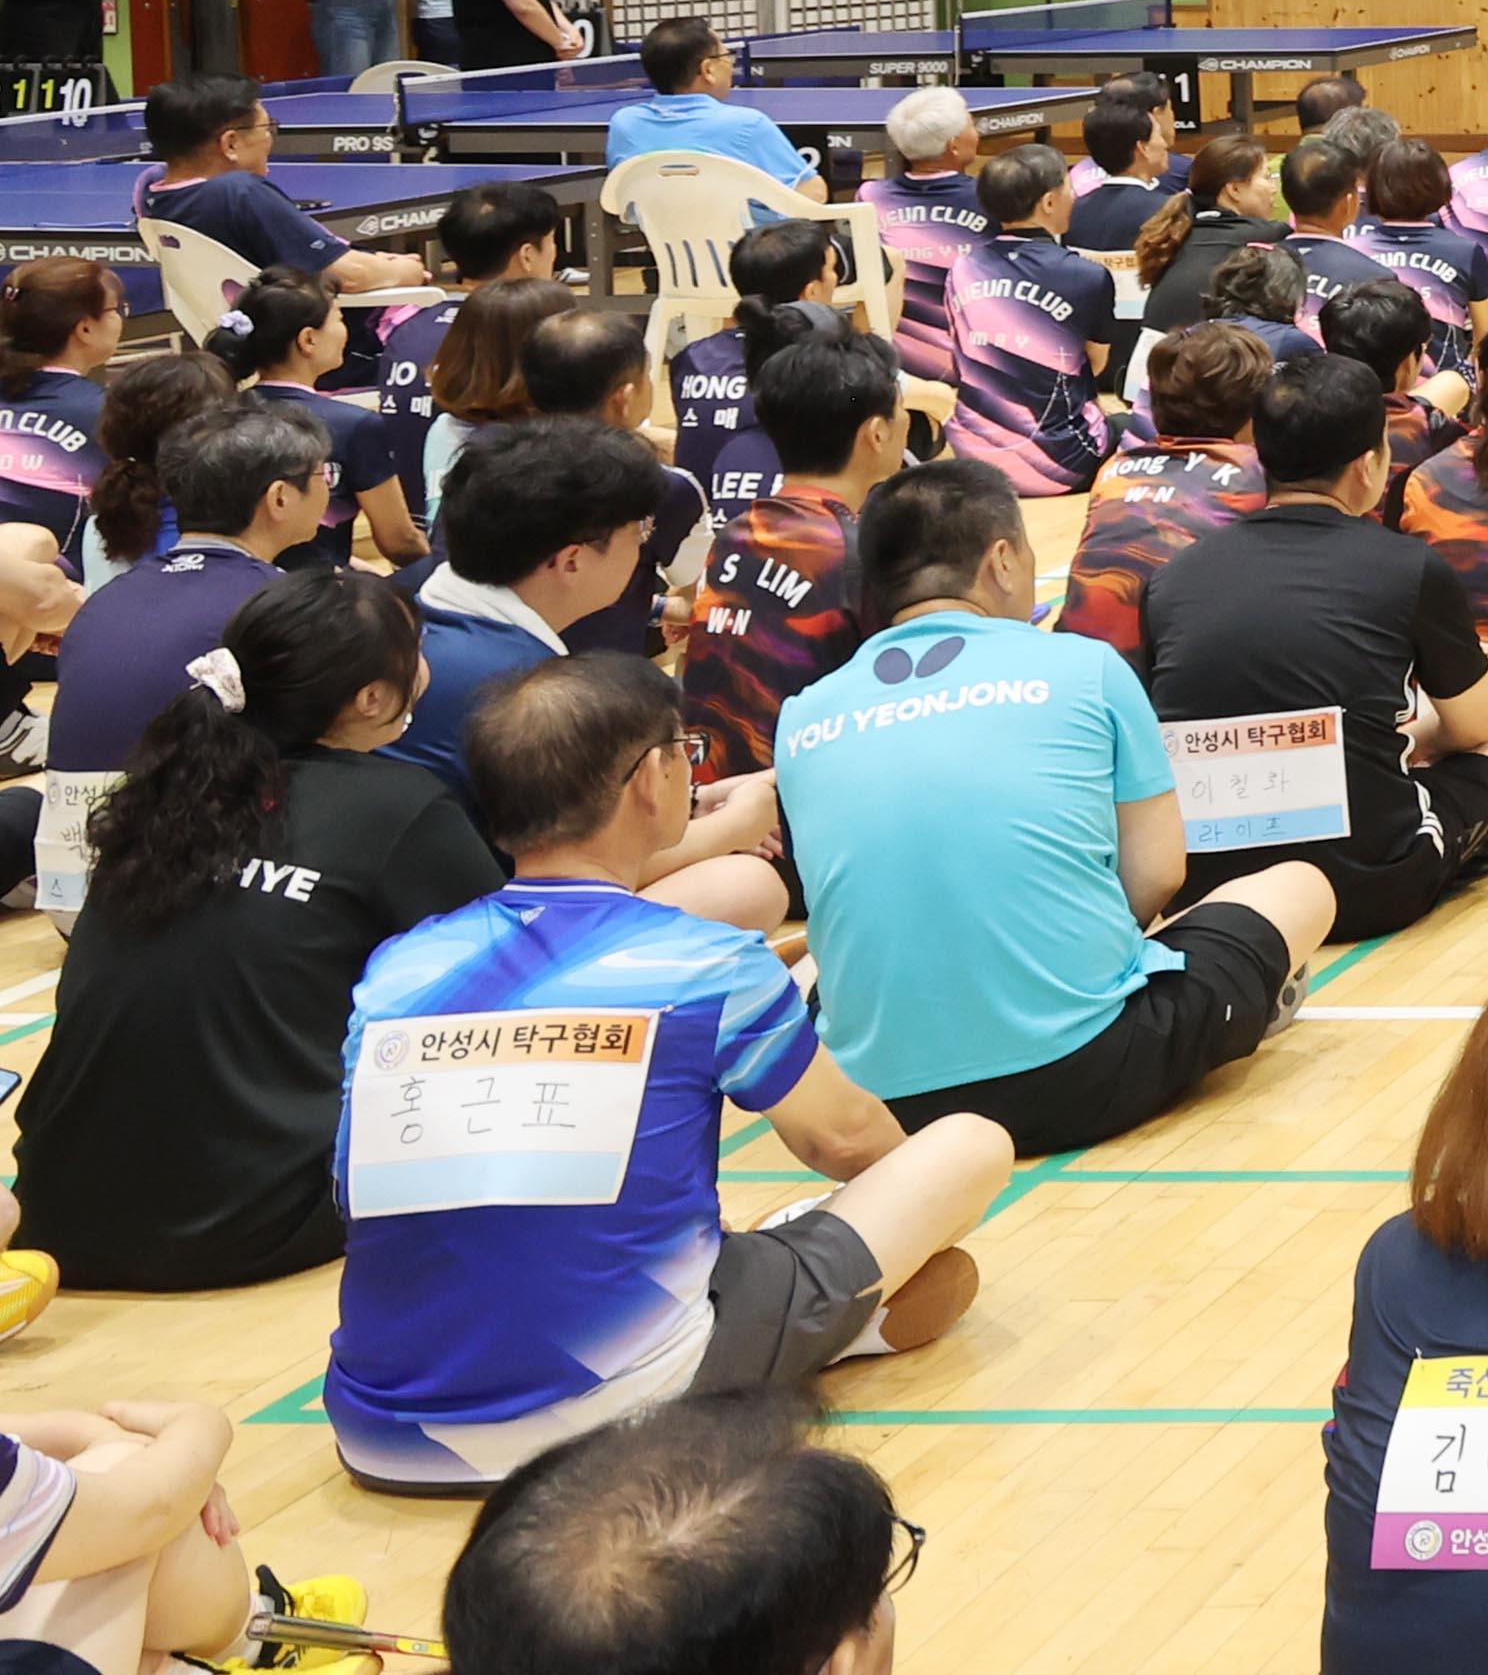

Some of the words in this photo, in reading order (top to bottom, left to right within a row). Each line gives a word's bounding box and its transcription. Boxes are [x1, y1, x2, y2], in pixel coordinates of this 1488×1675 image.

[869, 61, 916, 75] SUPER
[917, 61, 948, 74] 9000
[1220, 58, 1313, 70] CHAMPION
[988, 112, 1045, 132] CHAMPION
[333, 136, 367, 151] PRO
[370, 136, 394, 151] 9S
[930, 205, 988, 233] CLUB
[8, 245, 155, 263] CHAMPION
[1408, 253, 1457, 284] CLUB
[1013, 280, 1074, 322] CLUB
[385, 361, 417, 386] JO
[681, 374, 747, 400] HONG
[17, 410, 87, 453] CLUB
[713, 471, 763, 499] LEE
[720, 553, 740, 584] S
[755, 557, 812, 610] LIM
[785, 711, 848, 759] YOU
[851, 680, 1050, 737] YEONJONG
[1185, 728, 1240, 754] 안성시
[1247, 718, 1327, 748] 탁구협회
[419, 1028, 501, 1064] 안성시
[512, 1019, 634, 1062] 탁구협회
